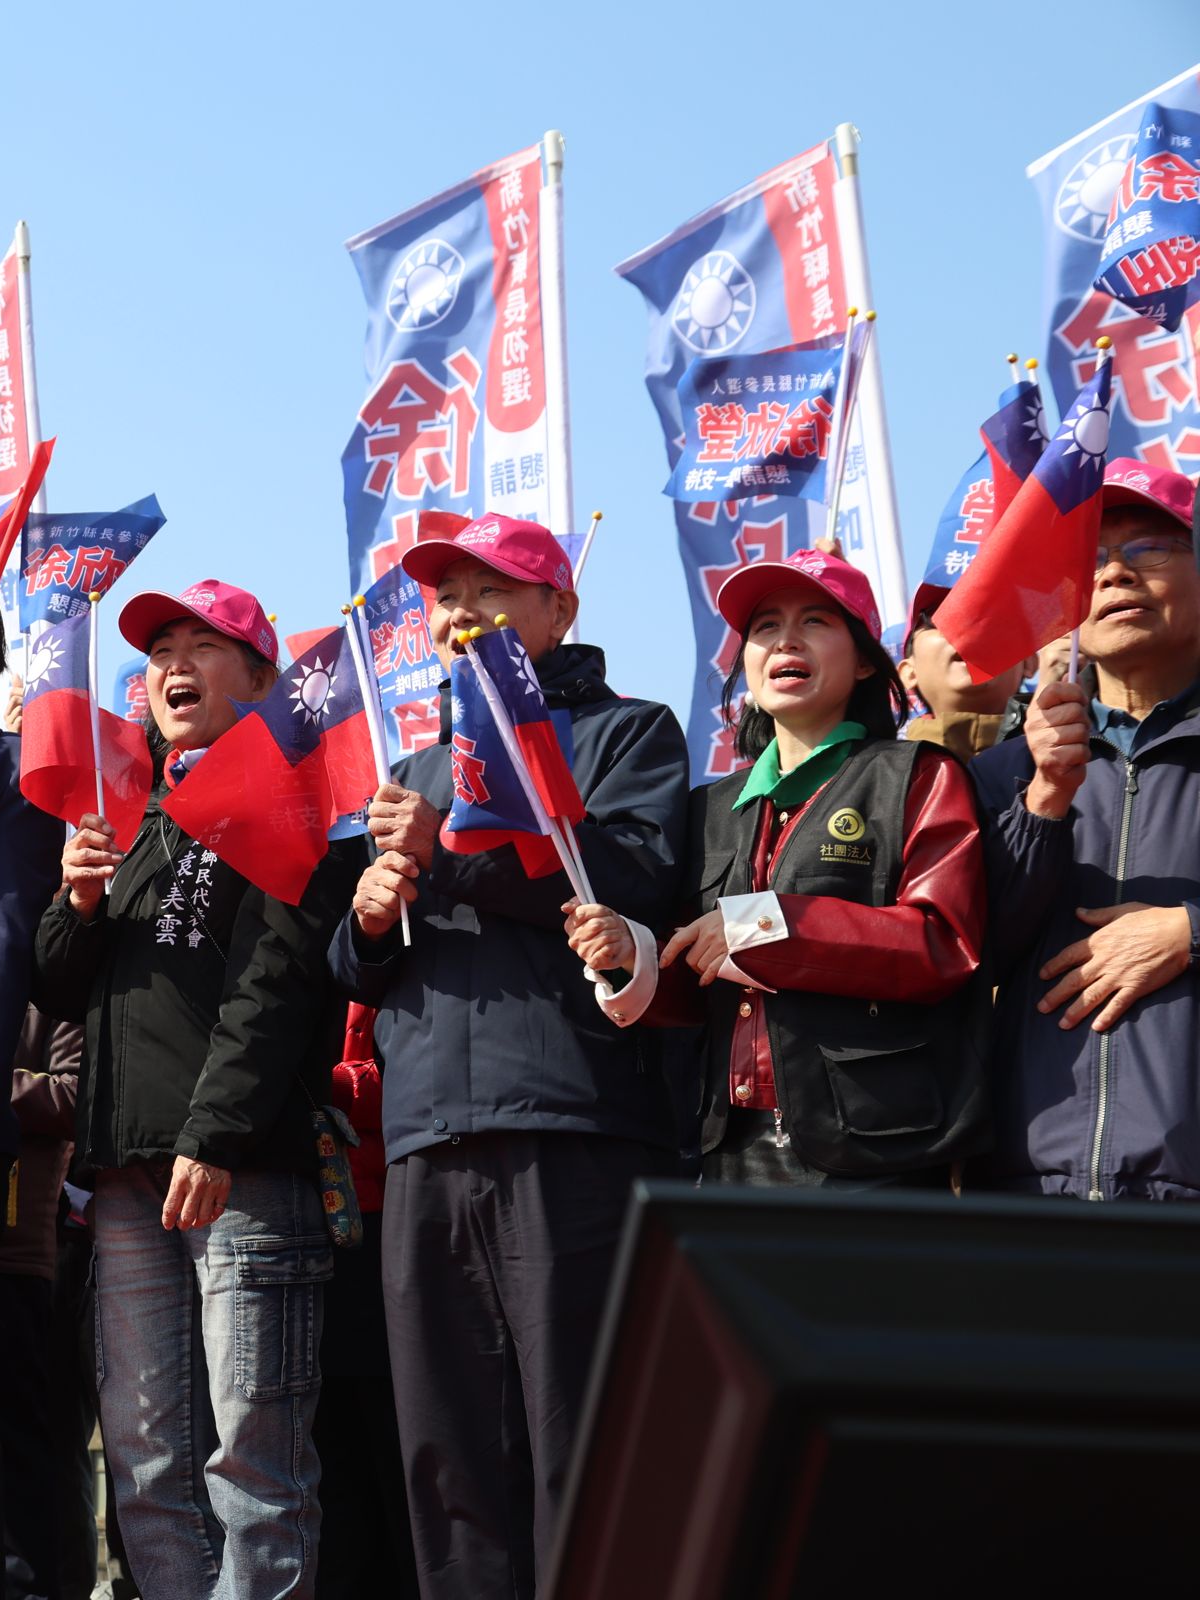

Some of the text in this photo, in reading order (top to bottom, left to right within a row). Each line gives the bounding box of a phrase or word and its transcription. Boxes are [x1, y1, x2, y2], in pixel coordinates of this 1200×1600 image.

[23, 544, 137, 597] 徐欣
[820, 844, 871, 861] 社團法人
[155, 850, 197, 946] 袁美雲
